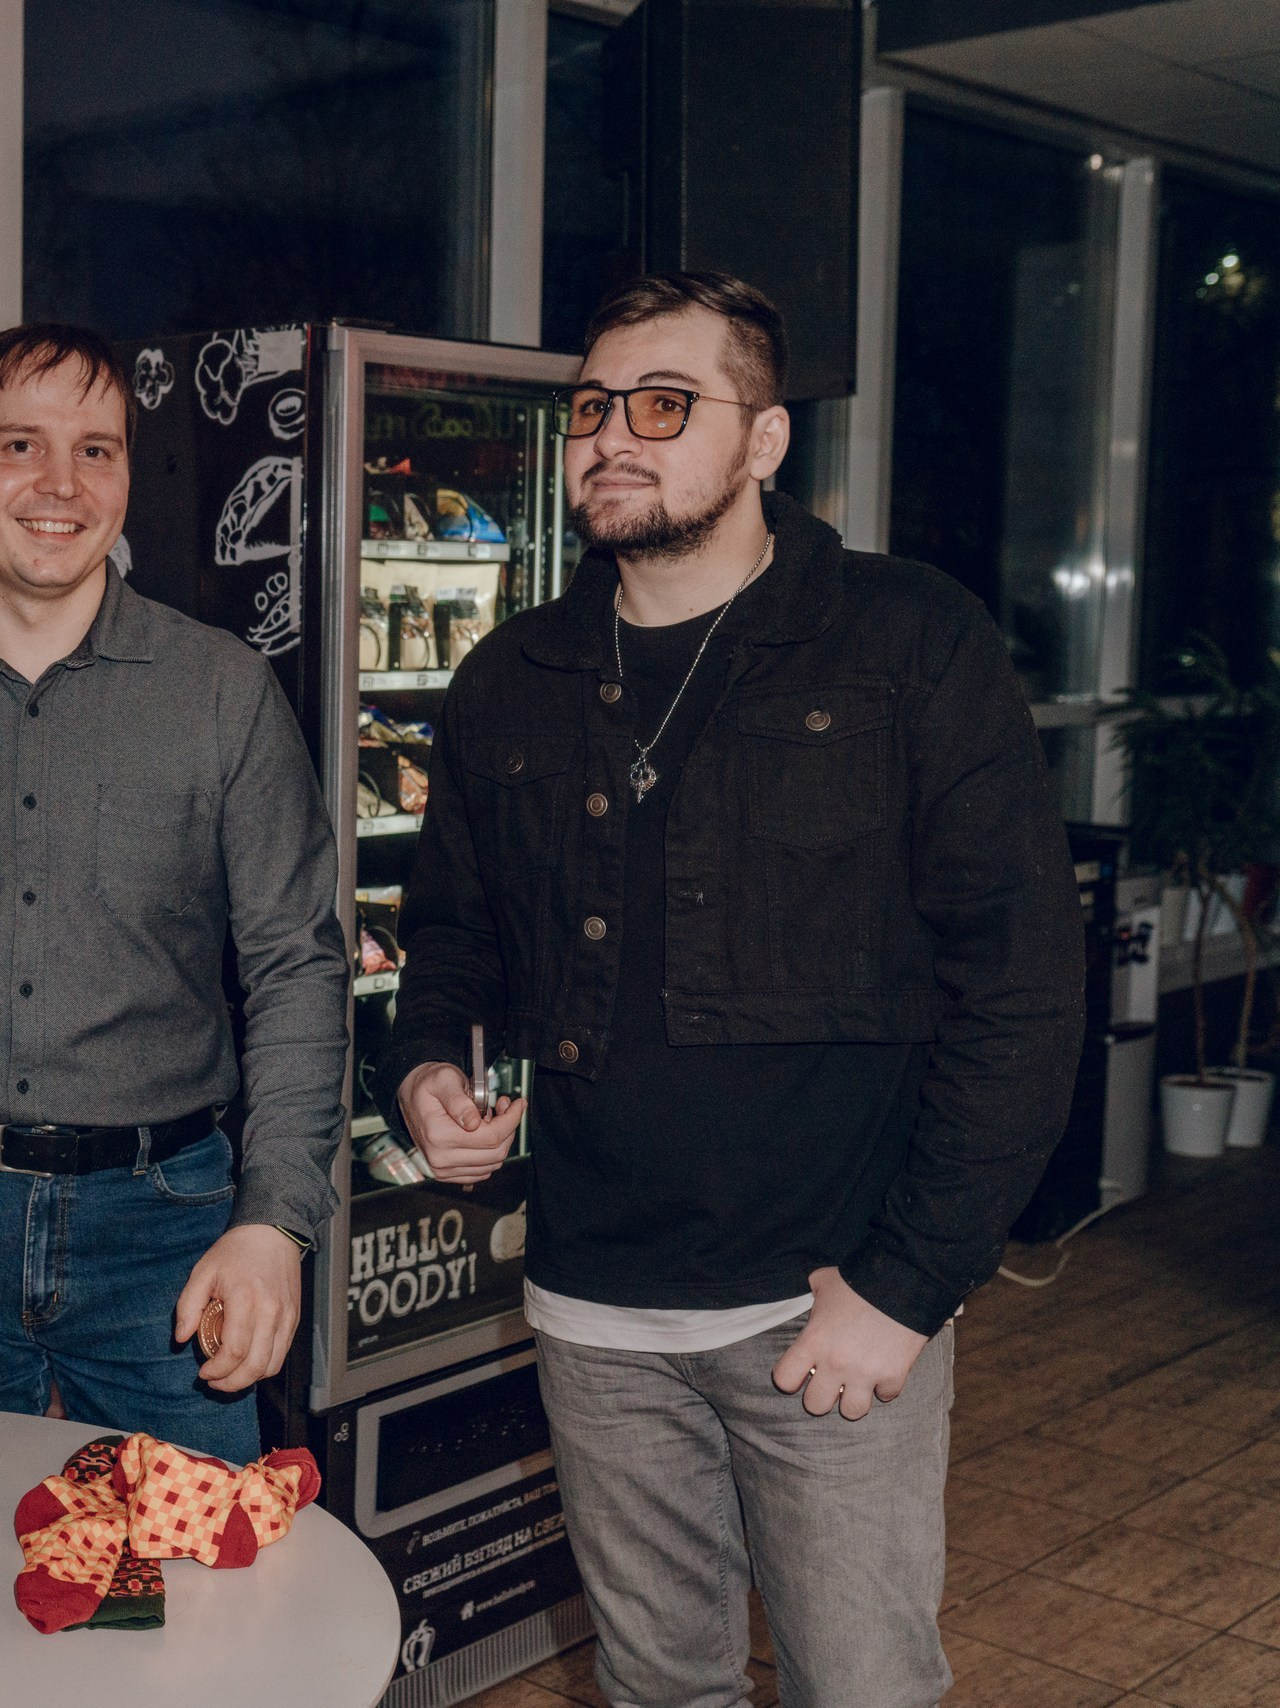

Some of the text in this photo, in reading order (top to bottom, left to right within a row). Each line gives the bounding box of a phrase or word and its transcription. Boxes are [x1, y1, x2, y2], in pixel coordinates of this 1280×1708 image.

[350, 1208, 467, 1283] HELLO,
[403, 1553, 463, 1594] СВЕЖИЙ
[464, 1535, 514, 1567] ВЗГЛЯД
[514, 1526, 533, 1547] НА
